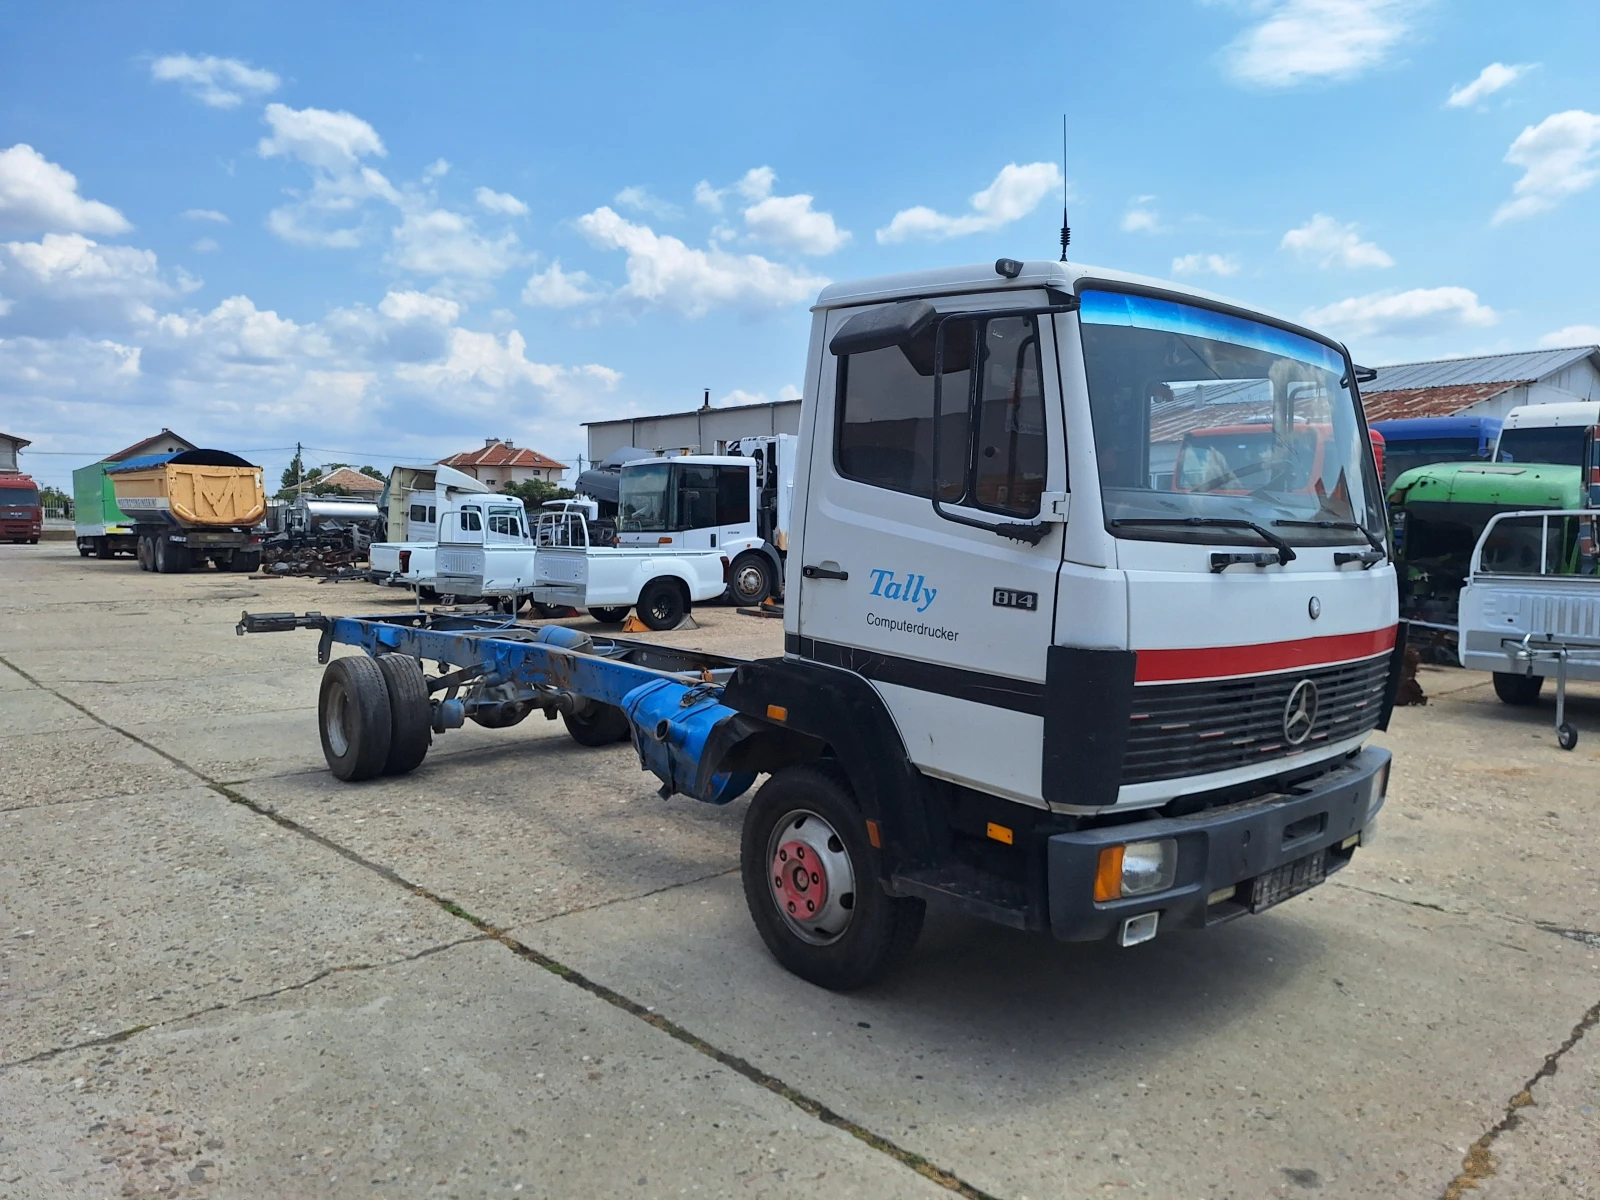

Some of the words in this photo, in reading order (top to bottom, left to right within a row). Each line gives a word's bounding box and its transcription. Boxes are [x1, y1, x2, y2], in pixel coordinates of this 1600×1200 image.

[869, 568, 937, 613] Tally
[994, 590, 1034, 608] 814
[866, 612, 959, 642] Computerdrucker
